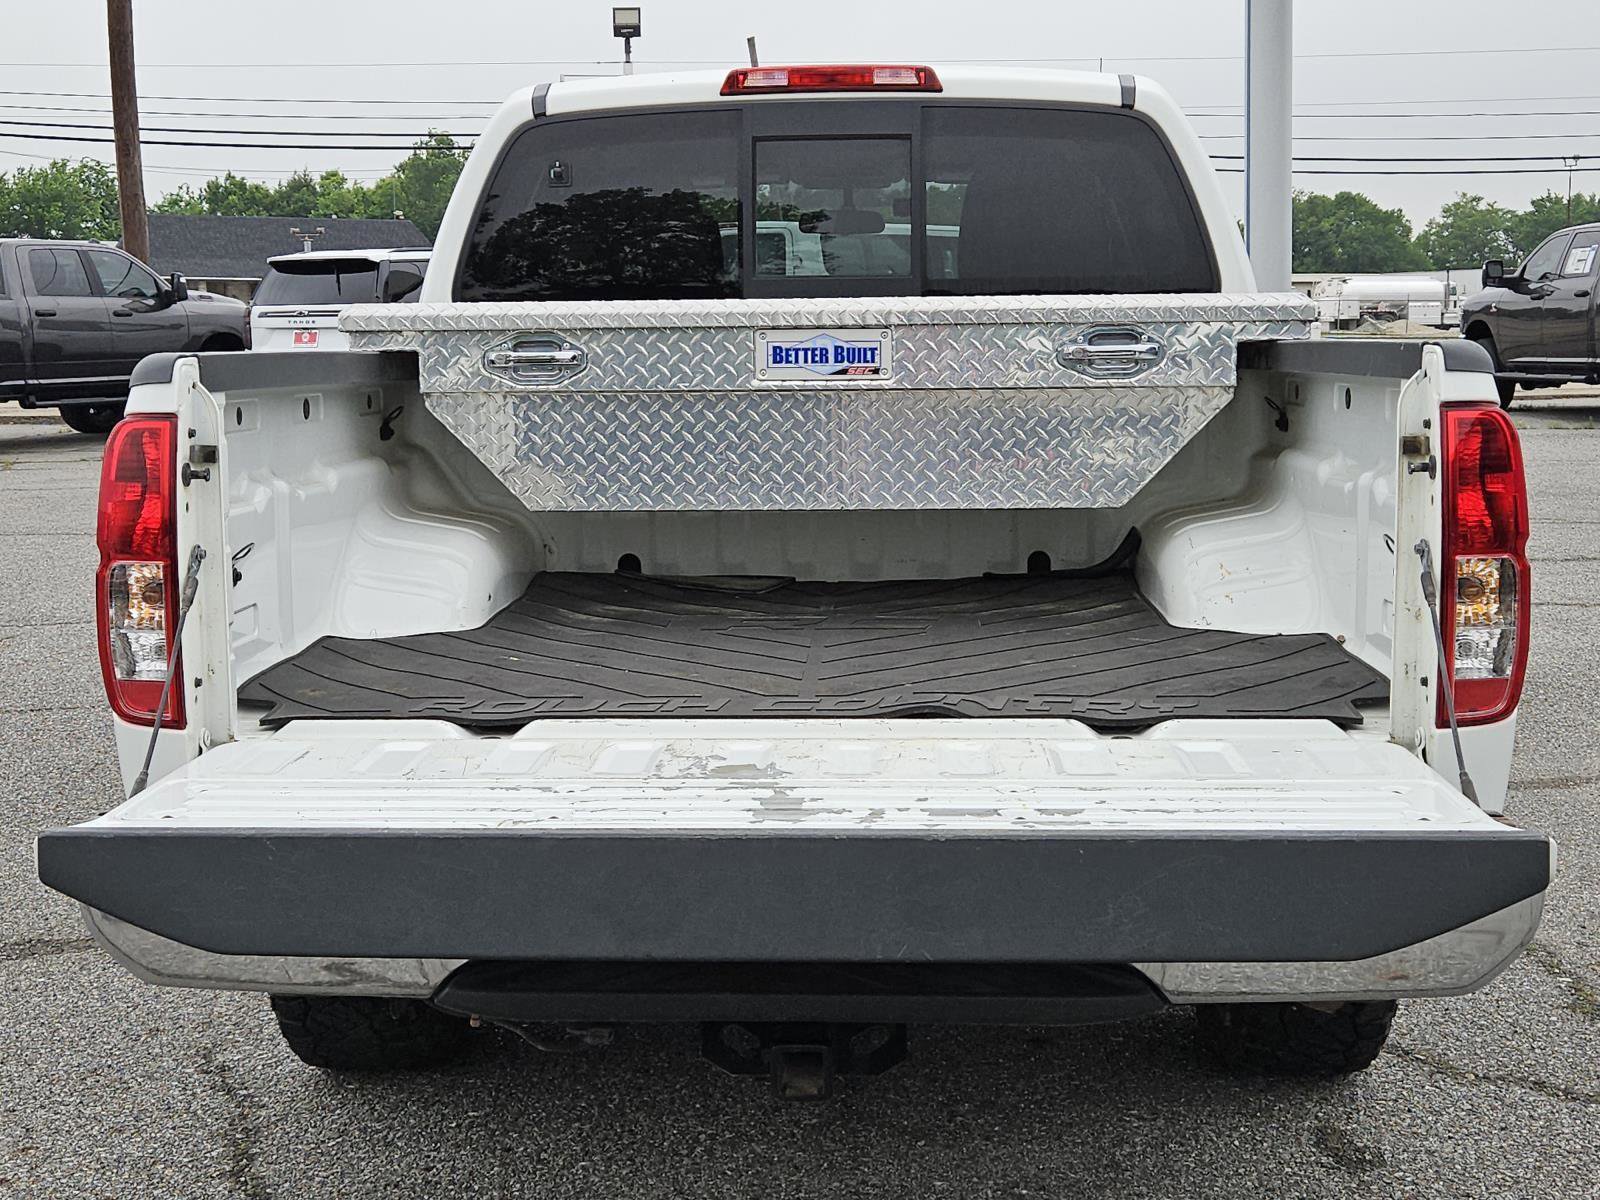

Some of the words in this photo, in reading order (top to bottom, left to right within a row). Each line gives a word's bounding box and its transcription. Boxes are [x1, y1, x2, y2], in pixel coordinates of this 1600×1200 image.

[772, 345, 829, 365] BETTER
[834, 345, 878, 365] BUILT
[846, 367, 875, 375] SEC
[408, 697, 731, 715] ROUGH
